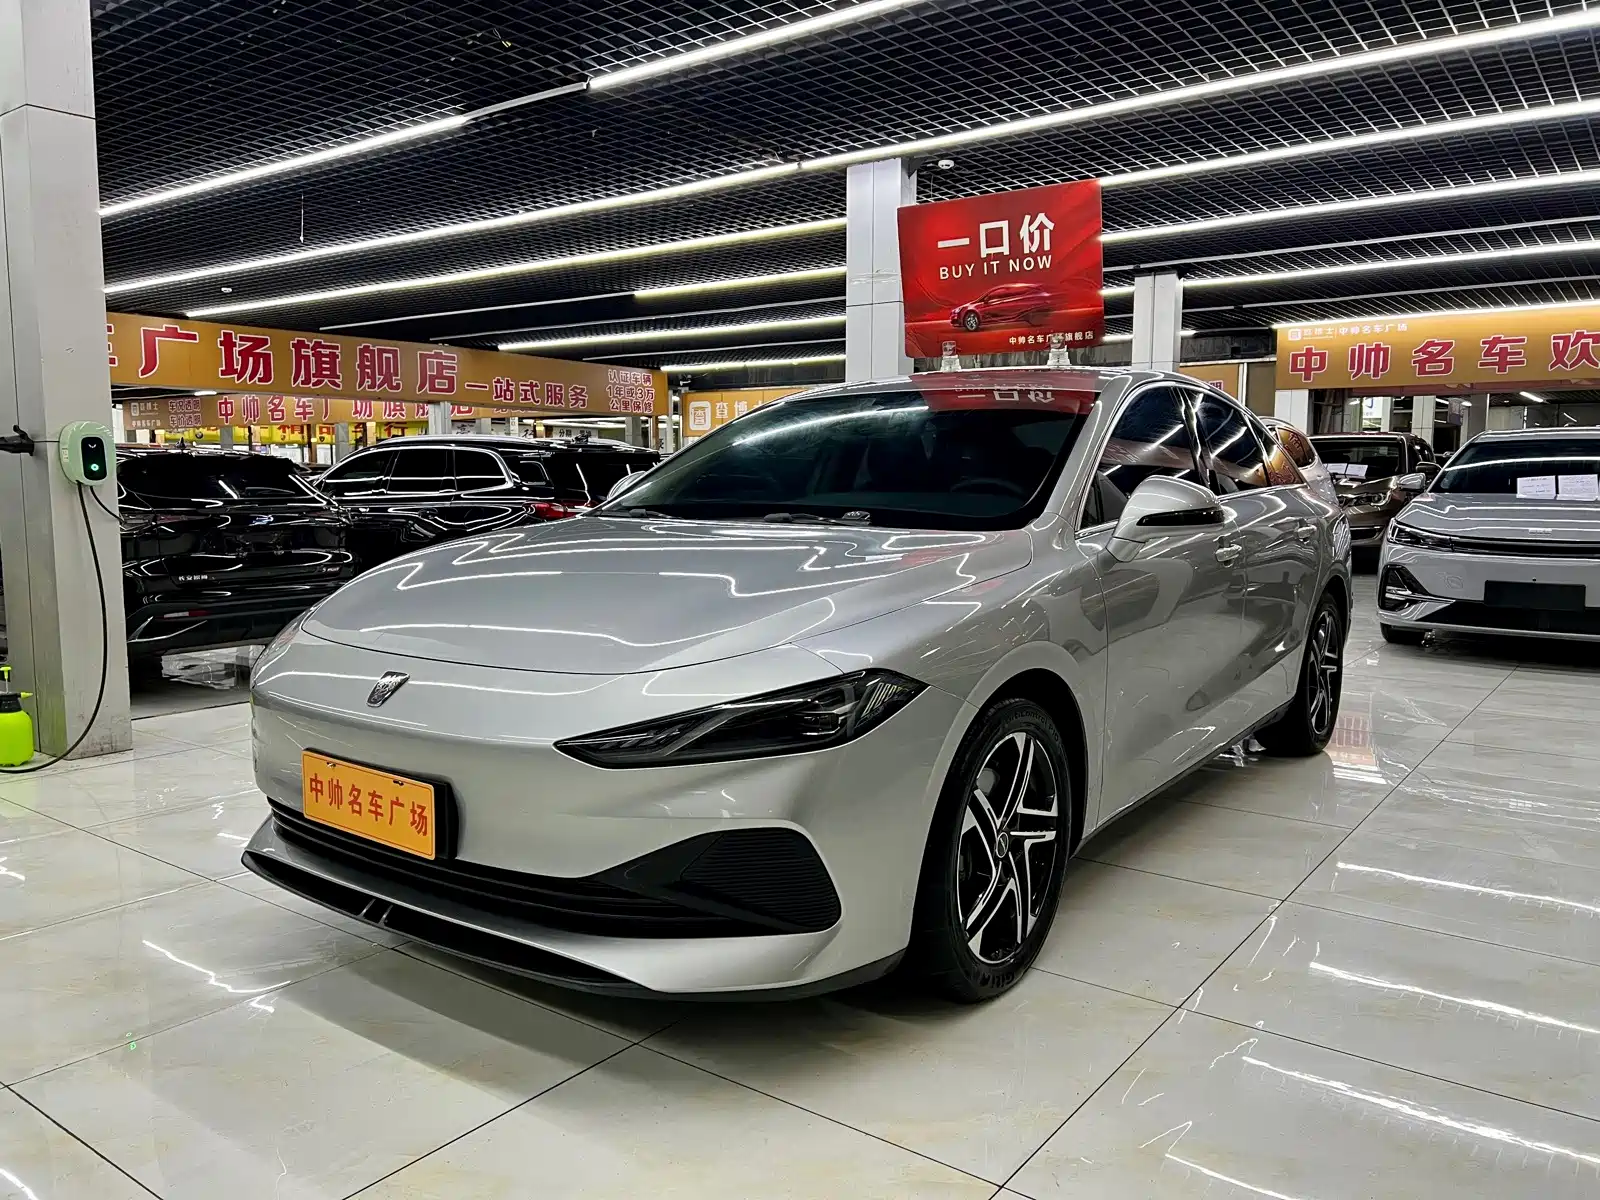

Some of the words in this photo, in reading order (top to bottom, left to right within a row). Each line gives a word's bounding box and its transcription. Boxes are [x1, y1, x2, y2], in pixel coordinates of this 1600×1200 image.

[937, 212, 1055, 258] 一口价
[939, 263, 975, 280] BUY
[984, 261, 999, 275] IT
[1009, 255, 1052, 273] NOW
[1339, 323, 1408, 335] 中帅名车广场
[107, 324, 457, 395] 广场旗舰店
[464, 376, 589, 409] 一站式服务
[1289, 330, 1600, 383] 中帅名车欢
[608, 369, 653, 386] 认证车辆
[606, 384, 655, 401] 1年或3万
[609, 399, 653, 413] 公里保修
[309, 773, 428, 837] 中帅名车广场
